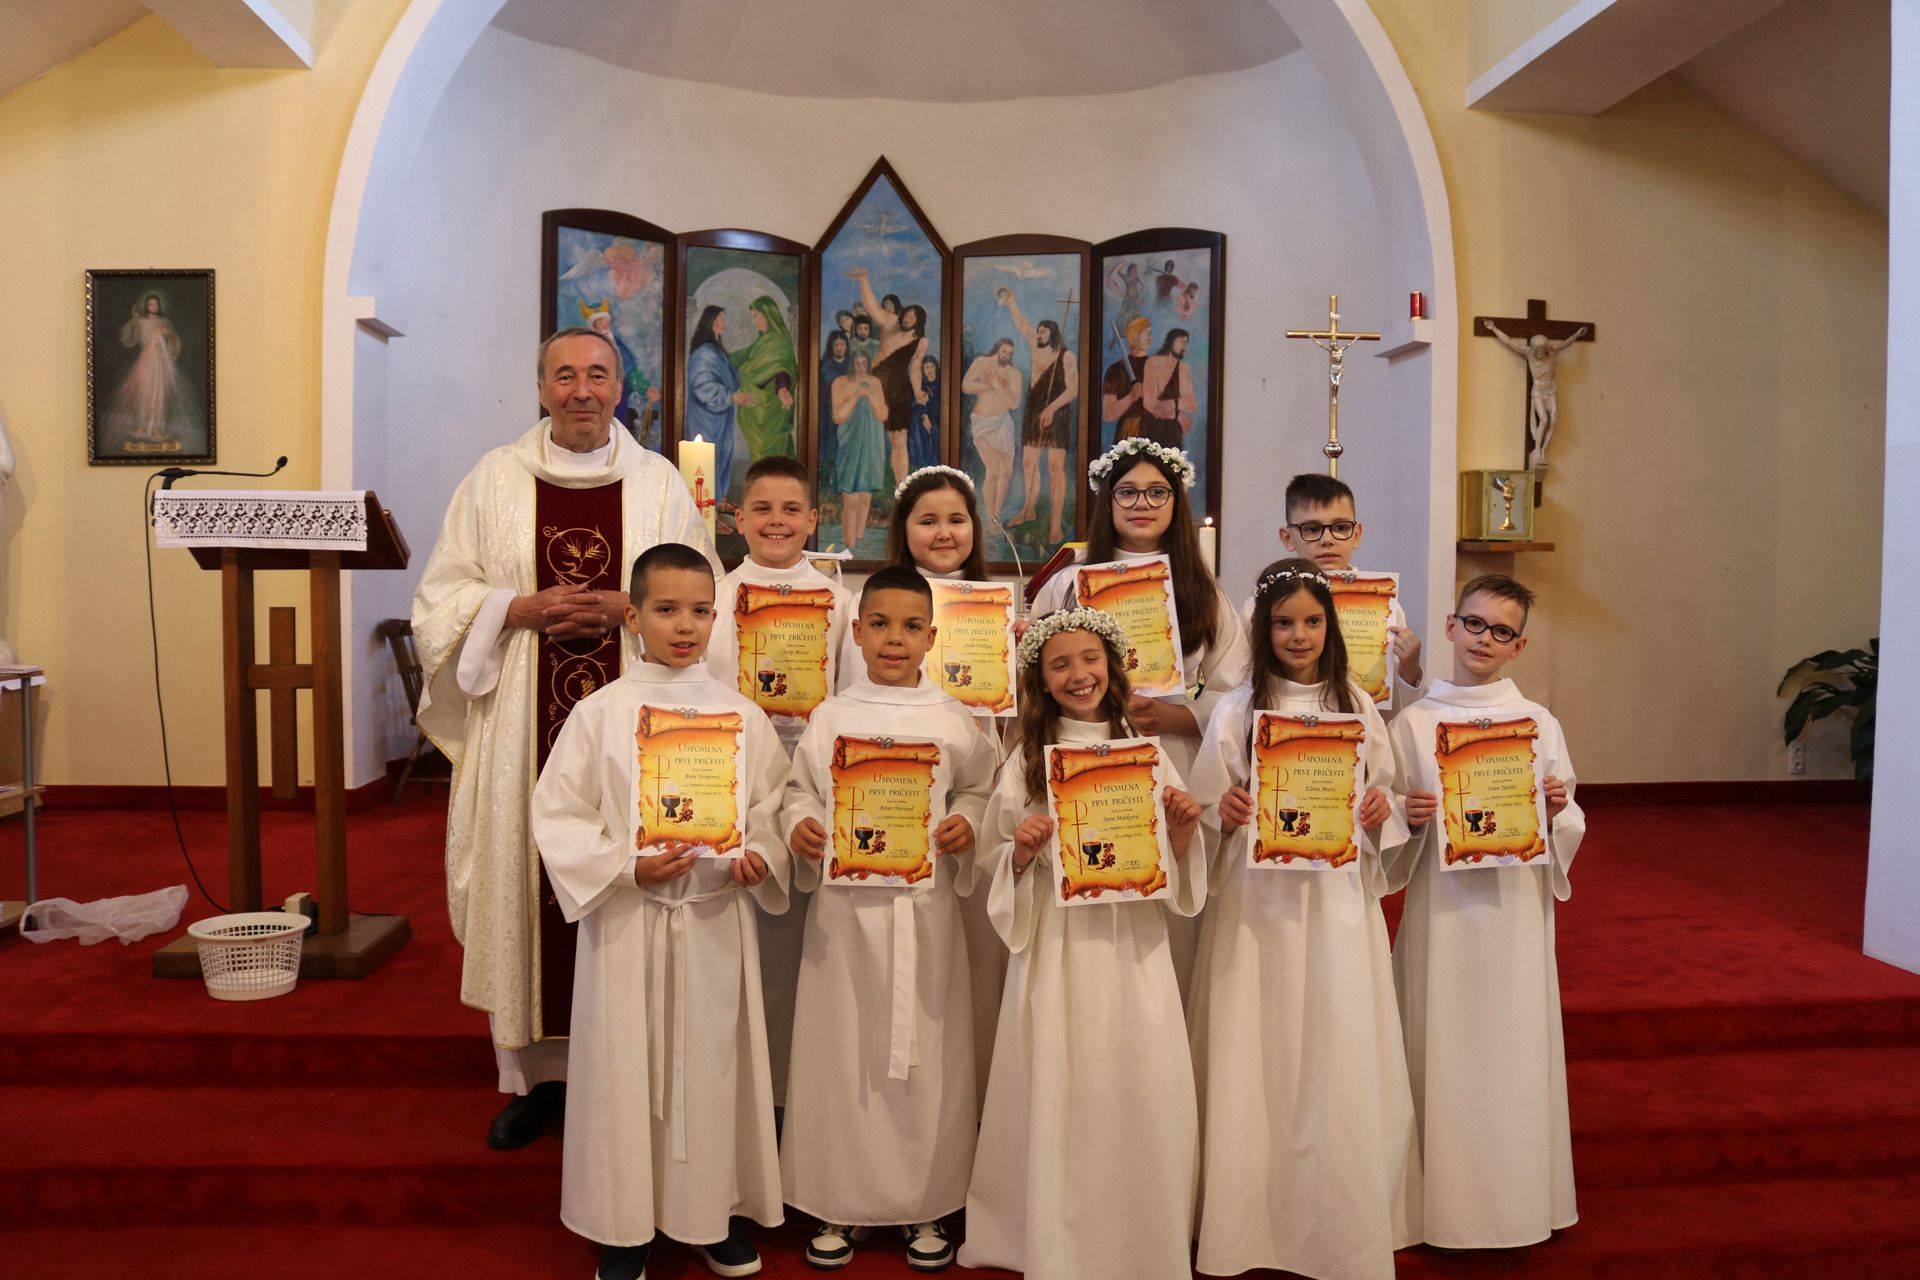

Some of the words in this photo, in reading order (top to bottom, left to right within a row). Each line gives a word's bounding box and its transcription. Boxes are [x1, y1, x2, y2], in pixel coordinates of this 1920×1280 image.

[774, 619, 814, 629] USPOMENA
[679, 743, 722, 753] USPOMENA
[695, 757, 724, 765] PRIČESTI
[1298, 753, 1342, 763] USPOMENA
[1476, 755, 1519, 765] USPOMENA
[1314, 769, 1344, 777] PRIČESTI
[1493, 768, 1522, 776] PRIČESTI
[874, 773, 917, 784] USPOMENA
[889, 789, 919, 797] PRIČESTI
[1094, 783, 1140, 793] USPOMENA
[1112, 797, 1143, 805] PRIČESTI
